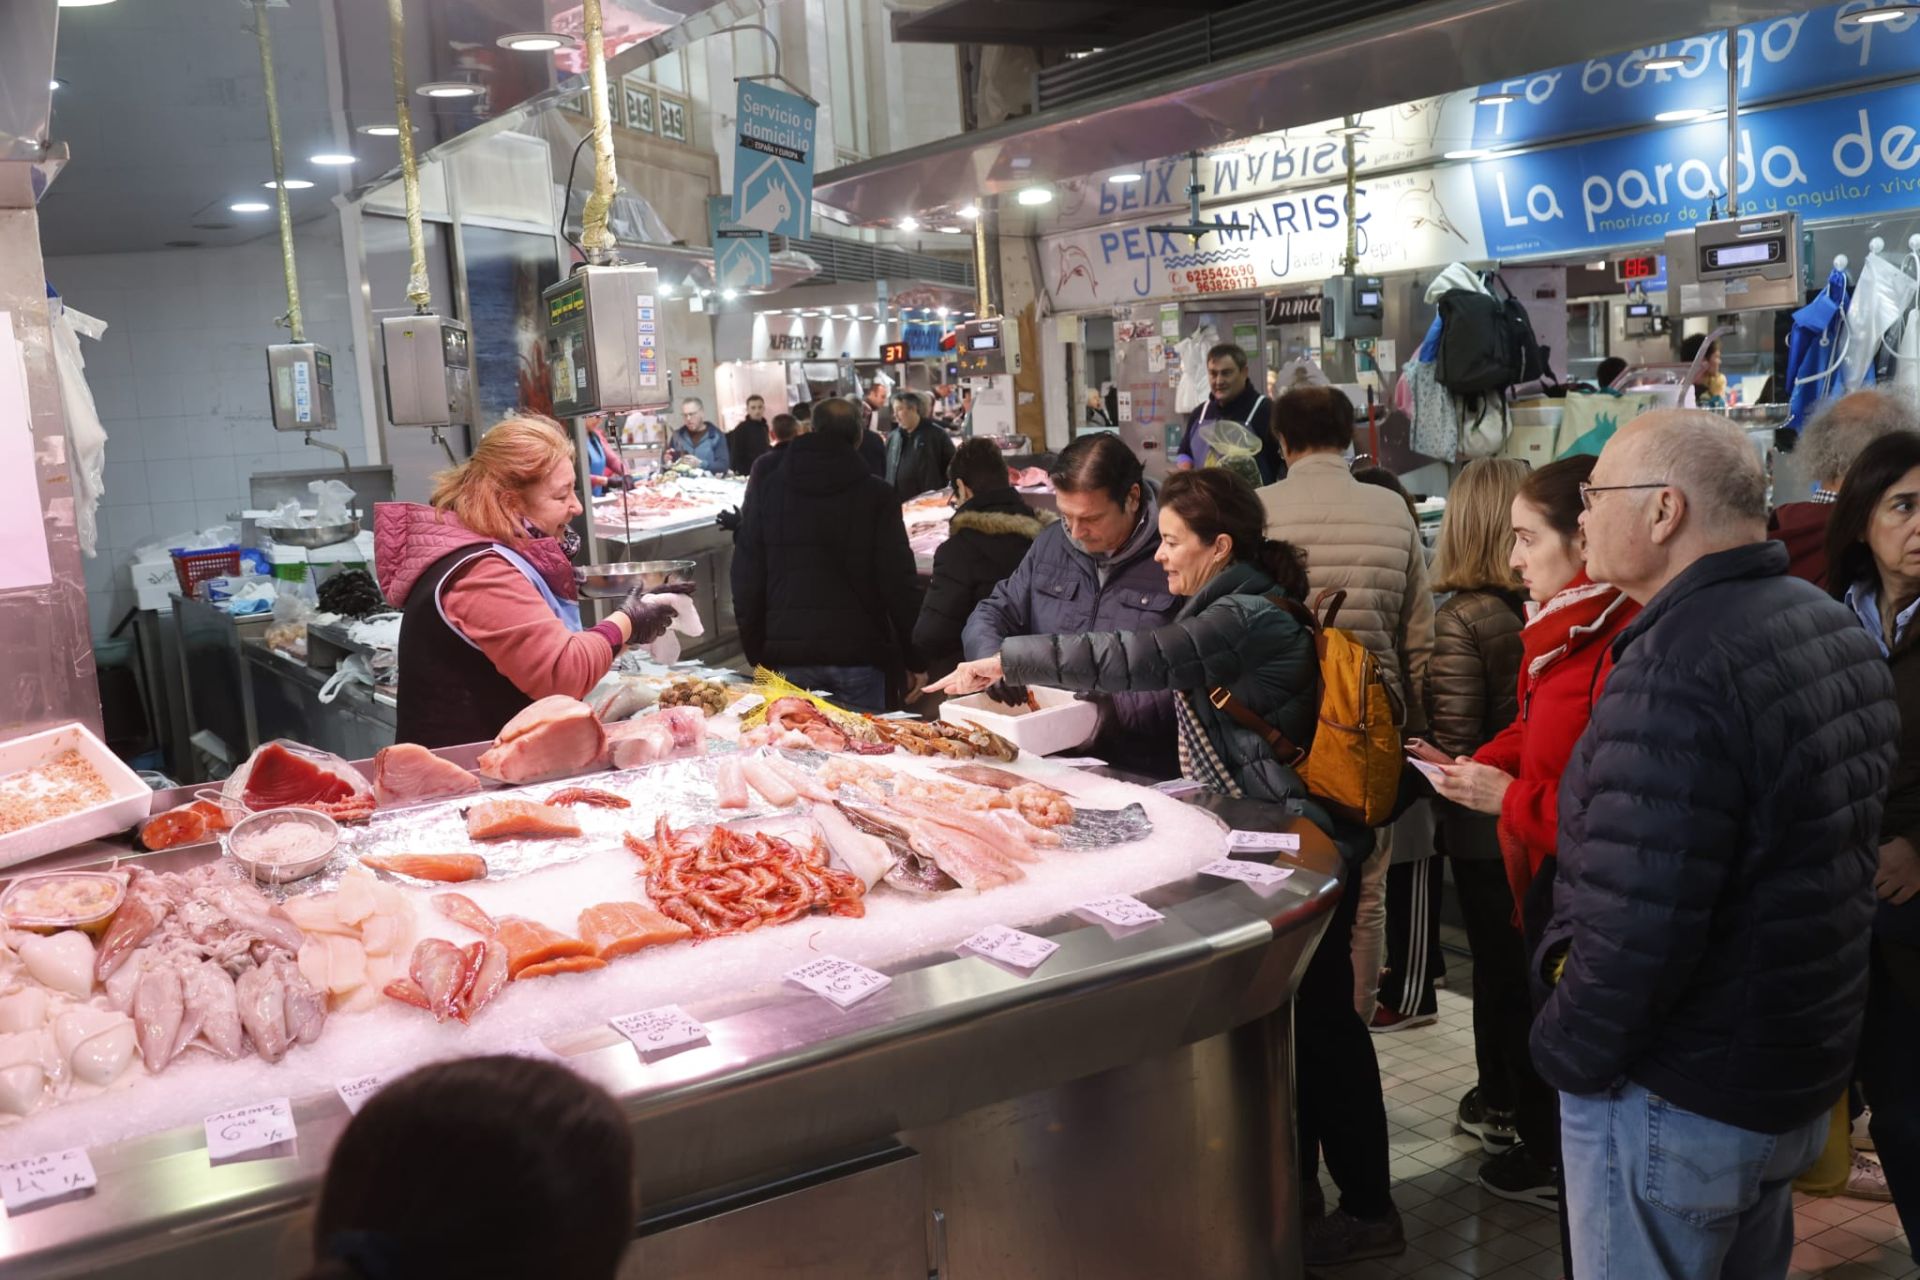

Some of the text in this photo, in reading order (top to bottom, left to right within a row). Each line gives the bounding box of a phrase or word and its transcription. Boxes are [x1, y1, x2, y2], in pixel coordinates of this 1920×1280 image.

[743, 94, 812, 131] Servicio a
[744, 117, 809, 152] domicilio
[754, 141, 774, 153] ESPAÑA
[1496, 108, 1920, 233] La parada de
[1600, 211, 1670, 232] mariscos
[1678, 205, 1698, 221] de
[1766, 197, 1777, 212] y
[1786, 183, 1871, 208] anguilas
[1100, 223, 1179, 264] PEIX
[1186, 263, 1255, 283] 625542690
[1625, 257, 1649, 277] 86
[1196, 277, 1258, 293] 963829173
[886, 345, 902, 361] 37
